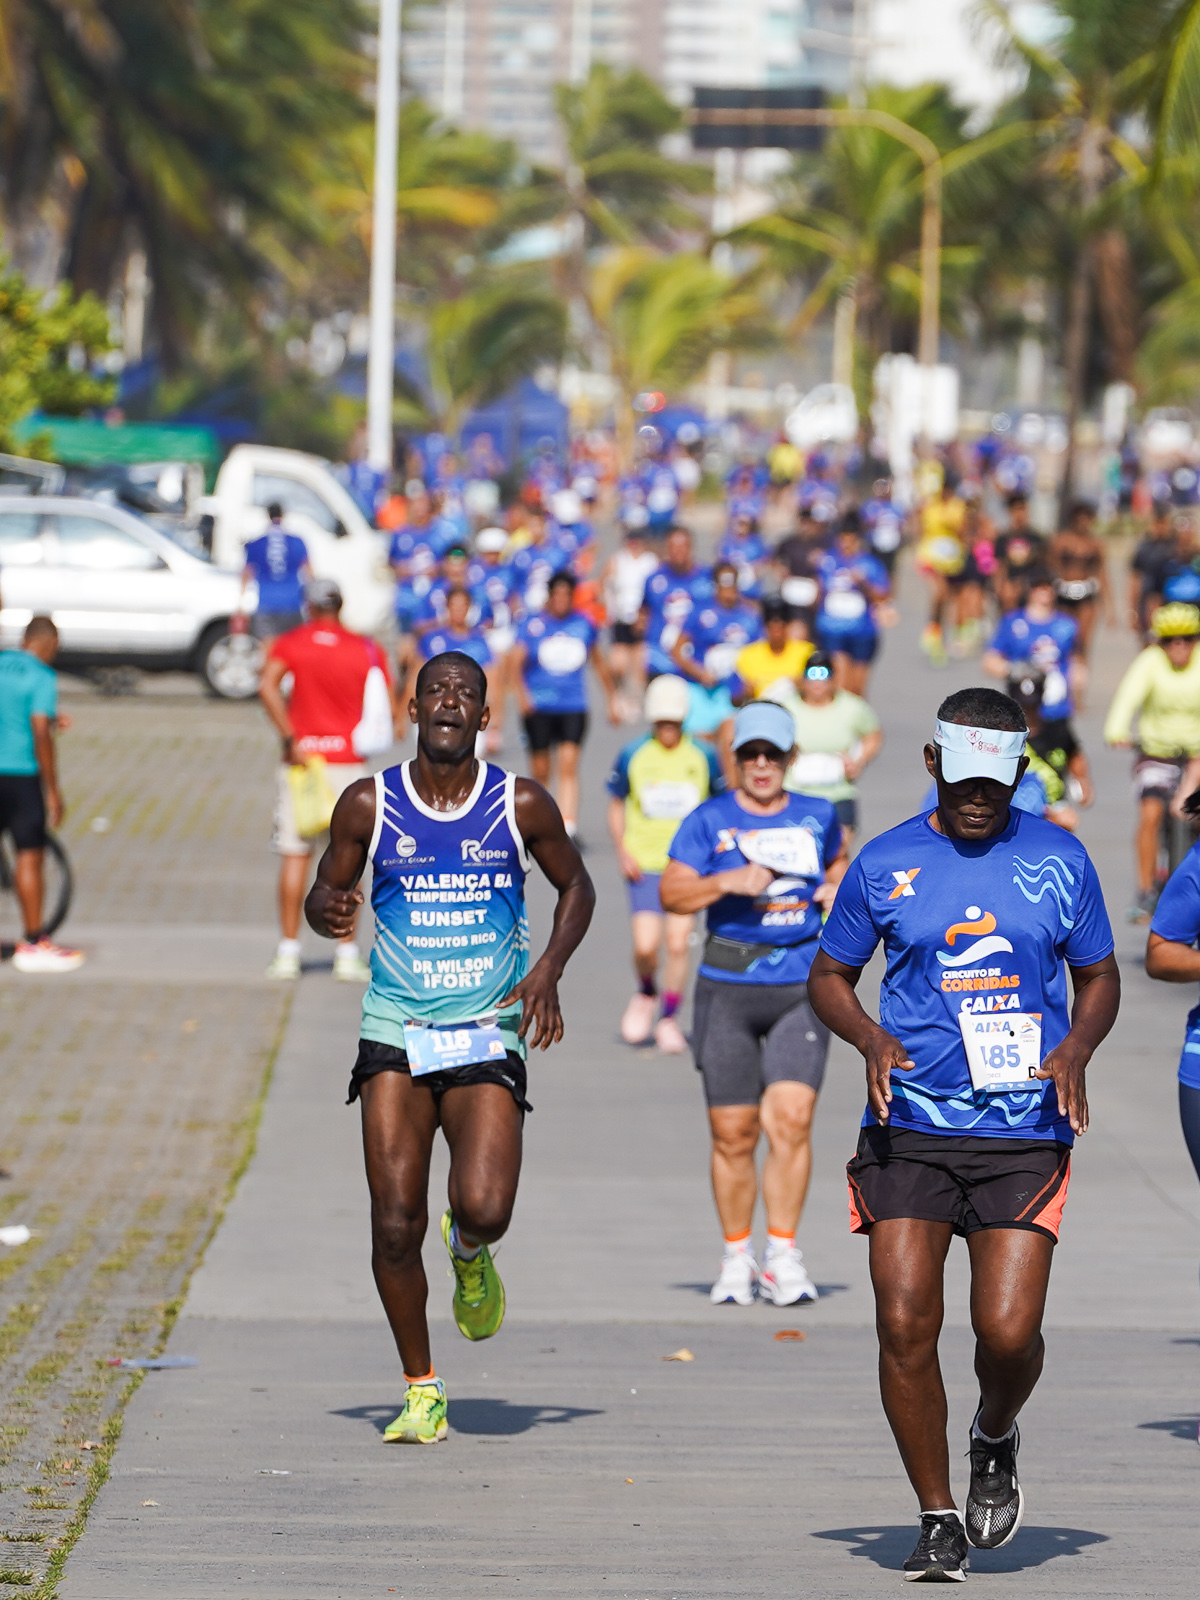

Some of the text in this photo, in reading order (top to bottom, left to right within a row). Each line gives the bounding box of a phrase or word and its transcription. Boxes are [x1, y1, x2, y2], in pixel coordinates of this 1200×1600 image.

[400, 873, 513, 891] VALENÇA BA
[403, 890, 492, 904] TEMPERADOS
[410, 908, 488, 927] SUNSET
[406, 932, 497, 949] PRODUTOS RICO
[412, 957, 494, 974] DR WILSON
[941, 967, 1001, 979] CIRCUITO DE
[422, 971, 485, 990] IFORT
[940, 975, 1020, 992] CORRIDAS
[960, 993, 1020, 1012] CAIXA
[974, 1021, 1011, 1033] AIXA
[430, 1028, 472, 1054] 118
